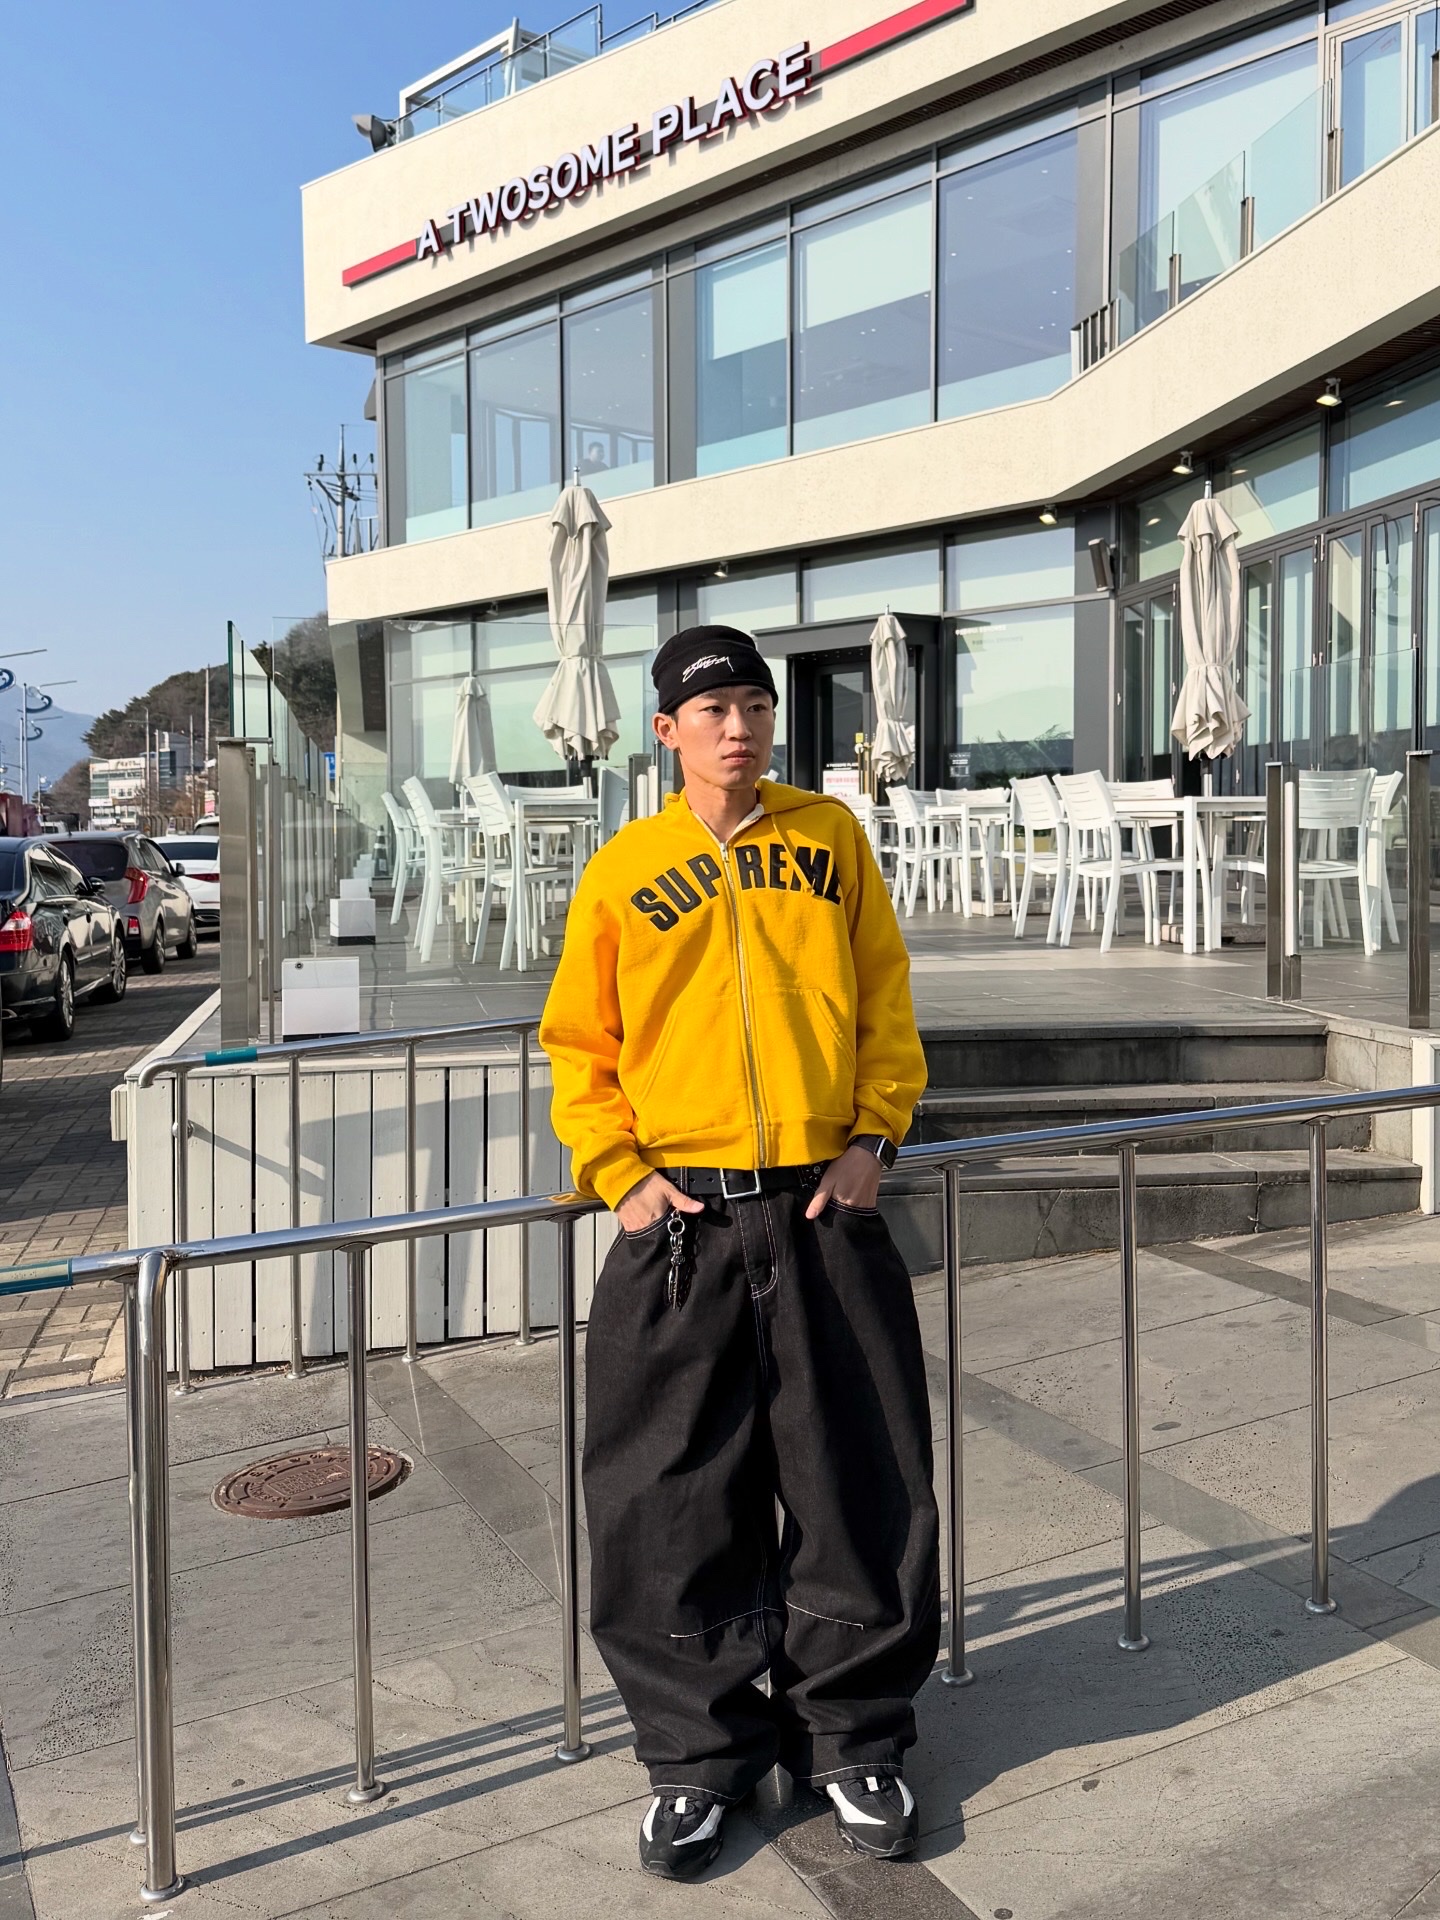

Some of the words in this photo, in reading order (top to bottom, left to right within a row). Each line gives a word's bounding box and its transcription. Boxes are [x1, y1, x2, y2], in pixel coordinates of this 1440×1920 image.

[418, 219, 443, 260] A
[446, 122, 640, 244] TWOSOME
[652, 41, 809, 155] PLACE
